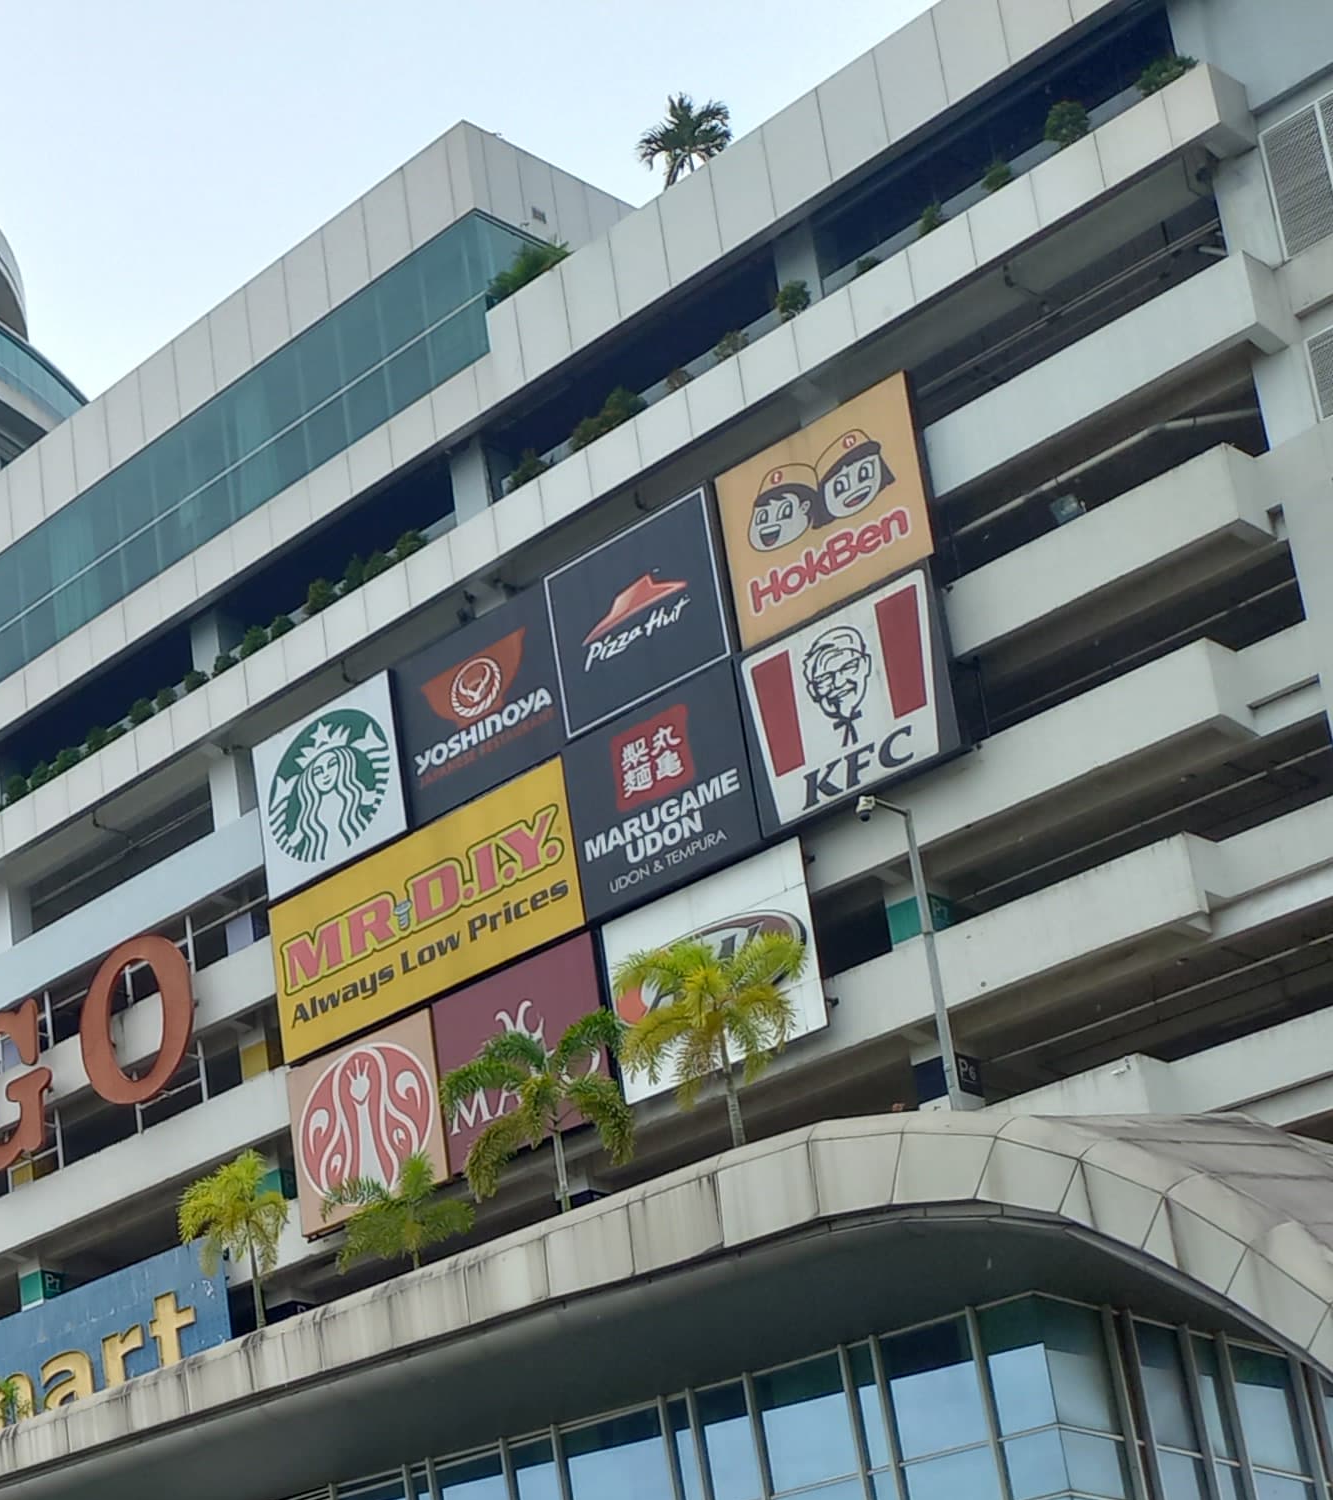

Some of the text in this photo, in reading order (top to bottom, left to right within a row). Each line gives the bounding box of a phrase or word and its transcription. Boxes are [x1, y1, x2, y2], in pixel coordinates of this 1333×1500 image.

[749, 507, 910, 614] HokBen
[585, 598, 690, 672] Pizza Hut
[414, 687, 552, 776] YOSHINOYA
[802, 725, 915, 811] KFC
[584, 768, 741, 862] MARUGAME
[626, 810, 704, 864] UDON
[609, 829, 728, 893] UDON & TEMPURA
[291, 879, 569, 1029] Always Low Prices
